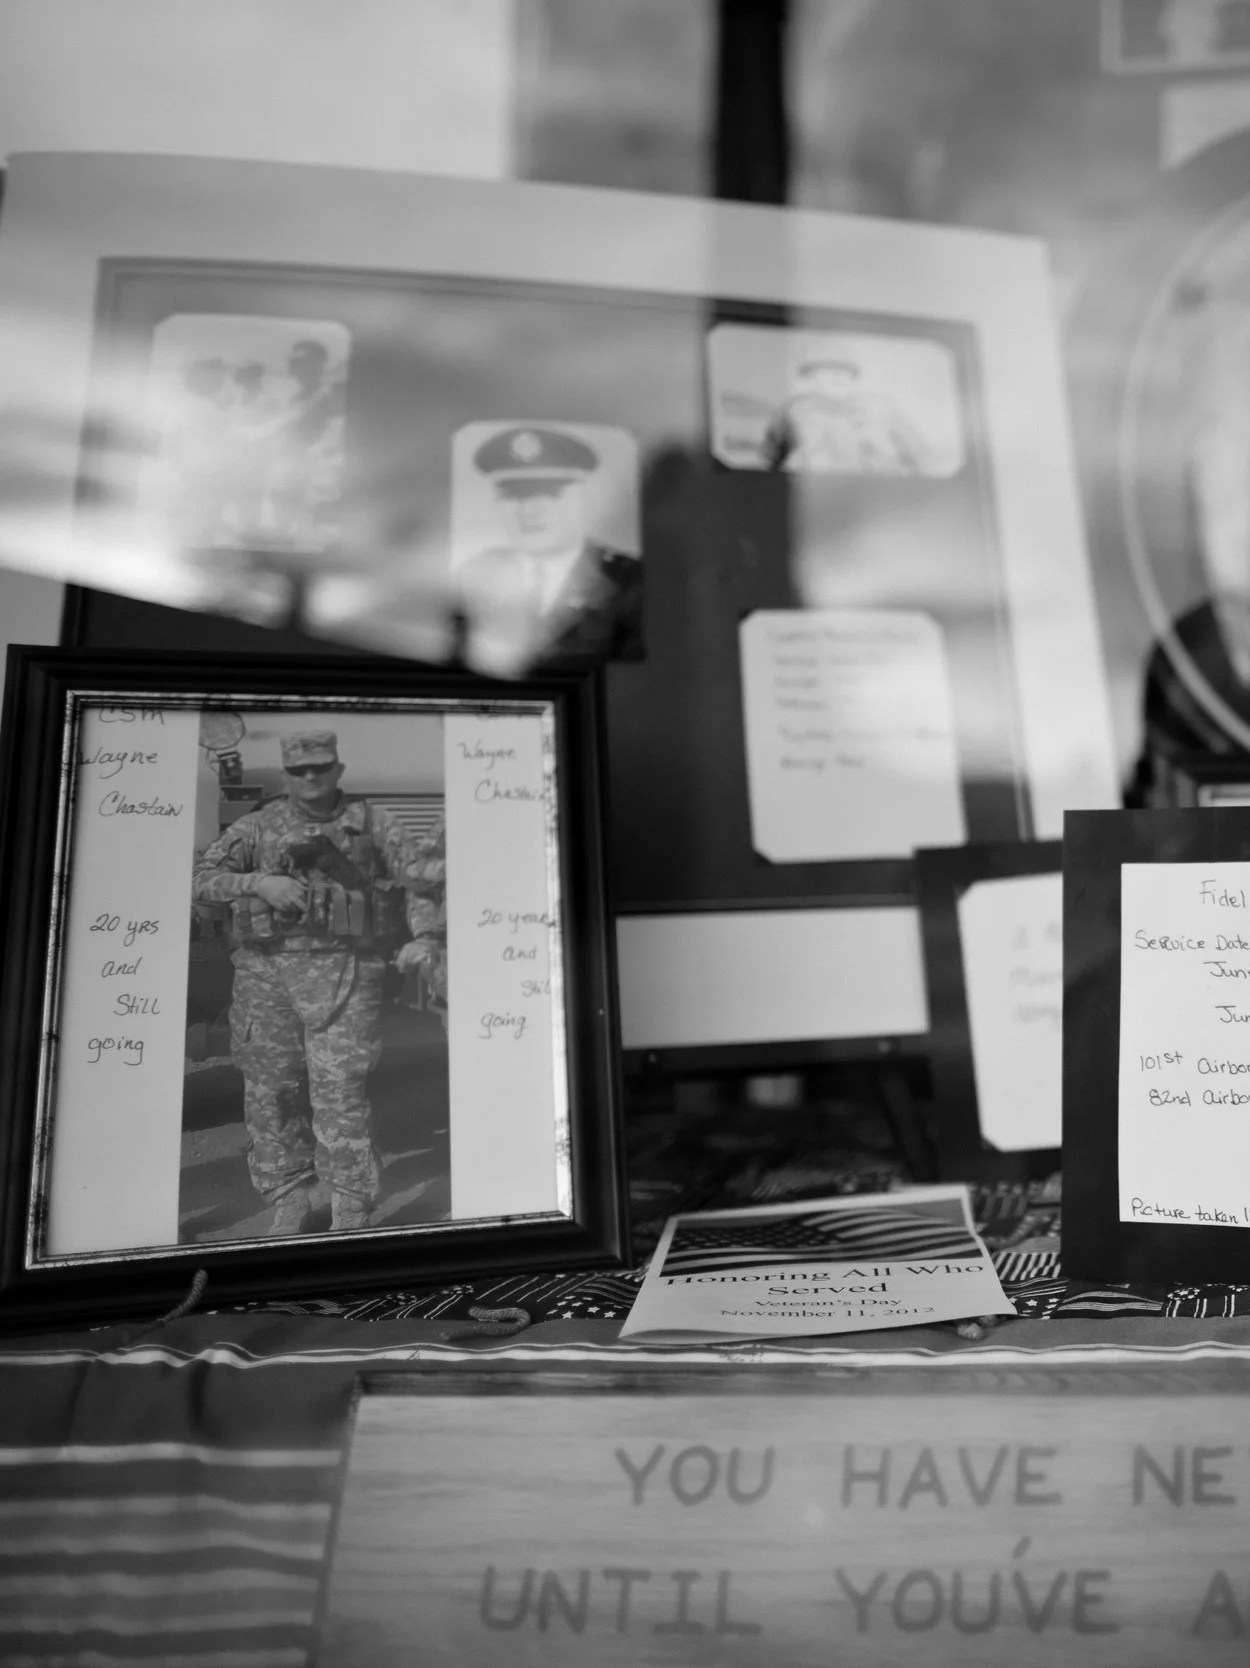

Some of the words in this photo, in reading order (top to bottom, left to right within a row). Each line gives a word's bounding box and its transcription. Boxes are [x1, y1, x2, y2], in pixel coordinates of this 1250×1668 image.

[1199, 879, 1247, 908] Fidel
[89, 913, 121, 932] 20
[477, 908, 502, 929] 20
[478, 1012, 527, 1040] going
[87, 1036, 144, 1066] going
[1140, 1051, 1184, 1072] 101st
[1148, 1088, 1192, 1106] 82nd
[1194, 1205, 1239, 1224] taken
[667, 1271, 831, 1285] Honoring
[842, 1267, 894, 1278] All
[905, 1264, 984, 1275] Who
[768, 1282, 888, 1296] Served
[721, 1309, 836, 1318] November
[882, 1306, 935, 1316] 2012
[755, 1299, 852, 1307] Veteran's
[861, 1299, 901, 1307] Day
[614, 1444, 775, 1507] YOU
[841, 1444, 1063, 1511] HAVE
[478, 1565, 764, 1634] UNTIL
[834, 1536, 1122, 1635] YOU'VE
